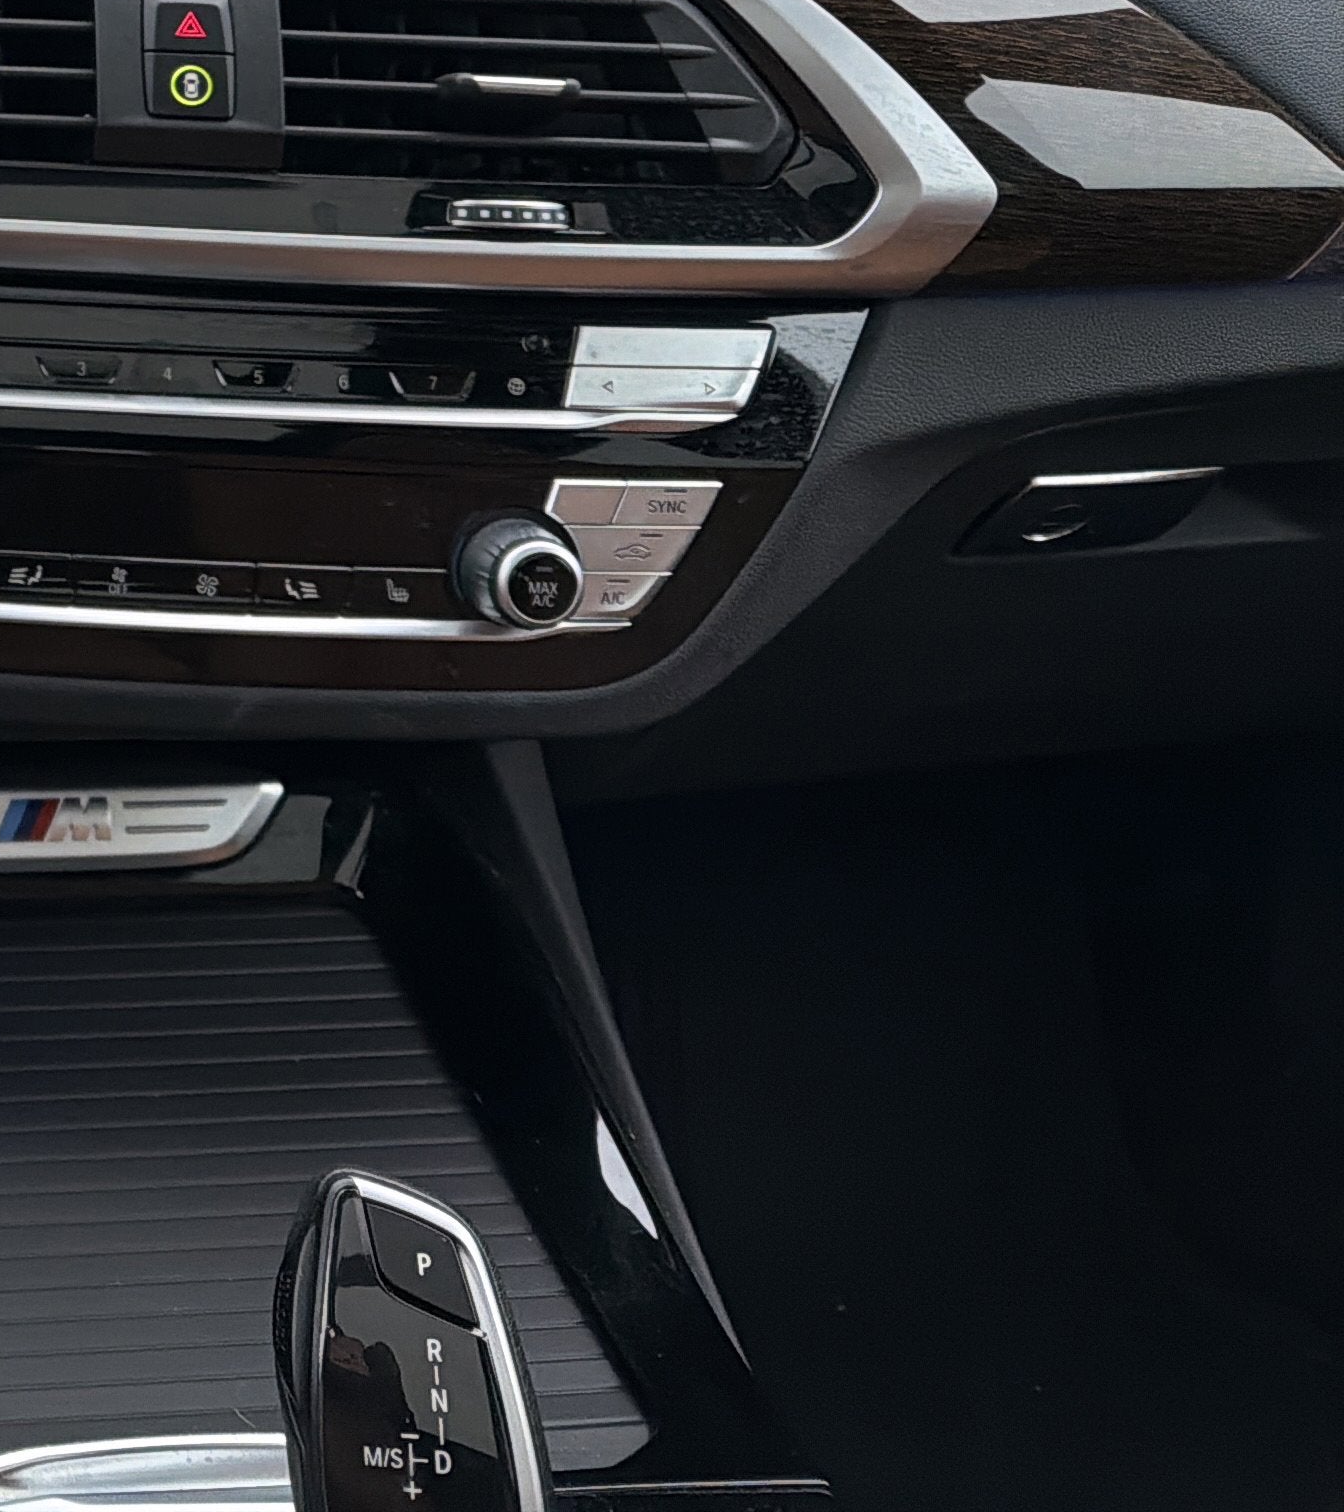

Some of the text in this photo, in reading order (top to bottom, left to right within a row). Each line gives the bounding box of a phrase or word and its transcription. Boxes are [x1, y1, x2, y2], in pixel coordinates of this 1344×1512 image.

[77, 361, 87, 377] 3
[163, 367, 173, 381] 4
[253, 369, 263, 385] 5
[338, 375, 349, 390] 6
[428, 375, 438, 391] 7
[647, 500, 687, 515] SYNC
[528, 581, 558, 596] MAX
[600, 591, 626, 606] A/C
[531, 595, 555, 608] A/C
[417, 1252, 432, 1276] P
[426, 1339, 443, 1363] R
[430, 1389, 449, 1413] N
[363, 1445, 453, 1475] M/S D
